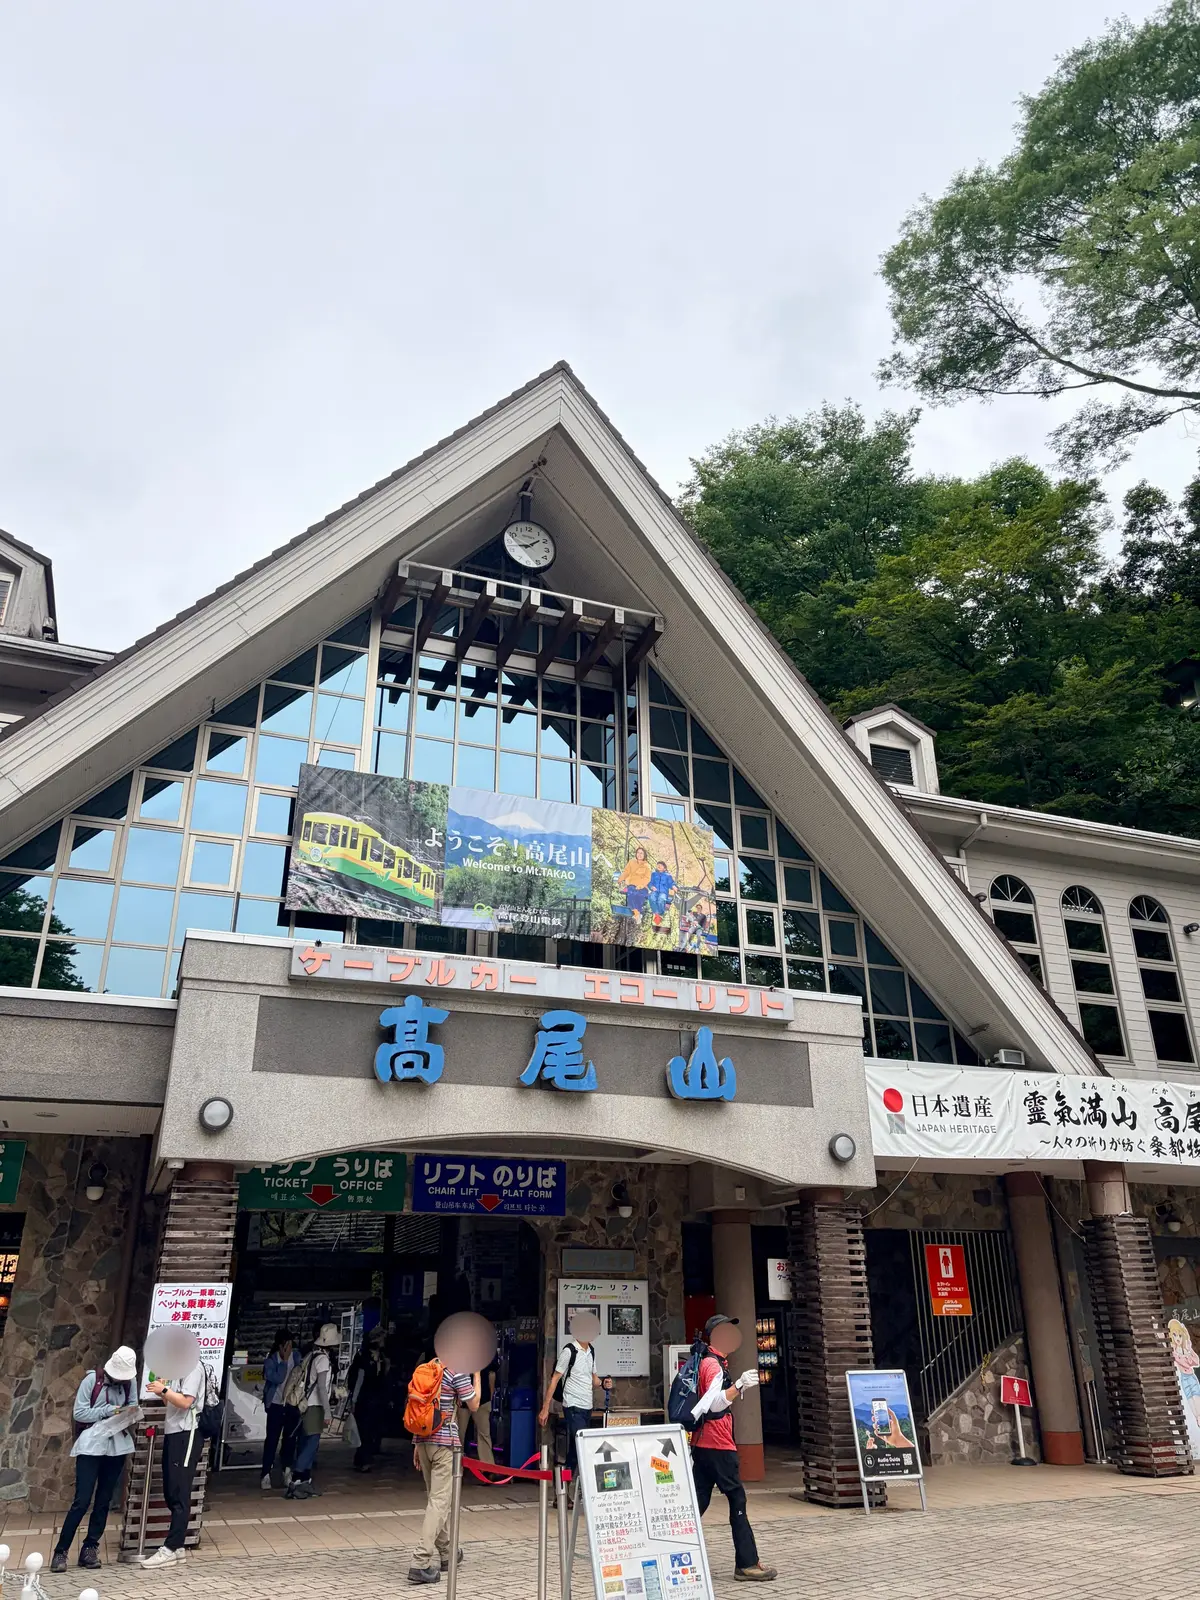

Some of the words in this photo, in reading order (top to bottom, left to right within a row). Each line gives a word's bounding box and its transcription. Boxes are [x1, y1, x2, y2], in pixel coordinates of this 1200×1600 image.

[463, 857, 510, 873] Welcome
[512, 864, 523, 874] to
[525, 866, 576, 881] Mt.TAKAO
[498, 911, 563, 927] 高尾登山電鉄
[298, 946, 537, 990] ケーブルカー
[584, 973, 785, 1017] エコーリフト
[912, 1093, 994, 1119] 日本遺産
[916, 1122, 947, 1134] JAPAN
[949, 1123, 997, 1135] HERITAGE
[333, 1157, 394, 1179] うりば
[423, 1162, 485, 1186] リフト
[493, 1165, 557, 1189] のりば
[263, 1177, 309, 1188] TICKET
[339, 1180, 384, 1191] OFFICE
[428, 1186, 456, 1196] CHAIR
[460, 1187, 480, 1196] LIFT
[502, 1189, 525, 1198] PLAT
[528, 1190, 552, 1199] FORM
[157, 1288, 227, 1297] ケーブルカー乗車には
[158, 1298, 223, 1309] ペットも乗車券が
[171, 1311, 207, 1322] 必要です。
[652, 1459, 669, 1470] Ticket
